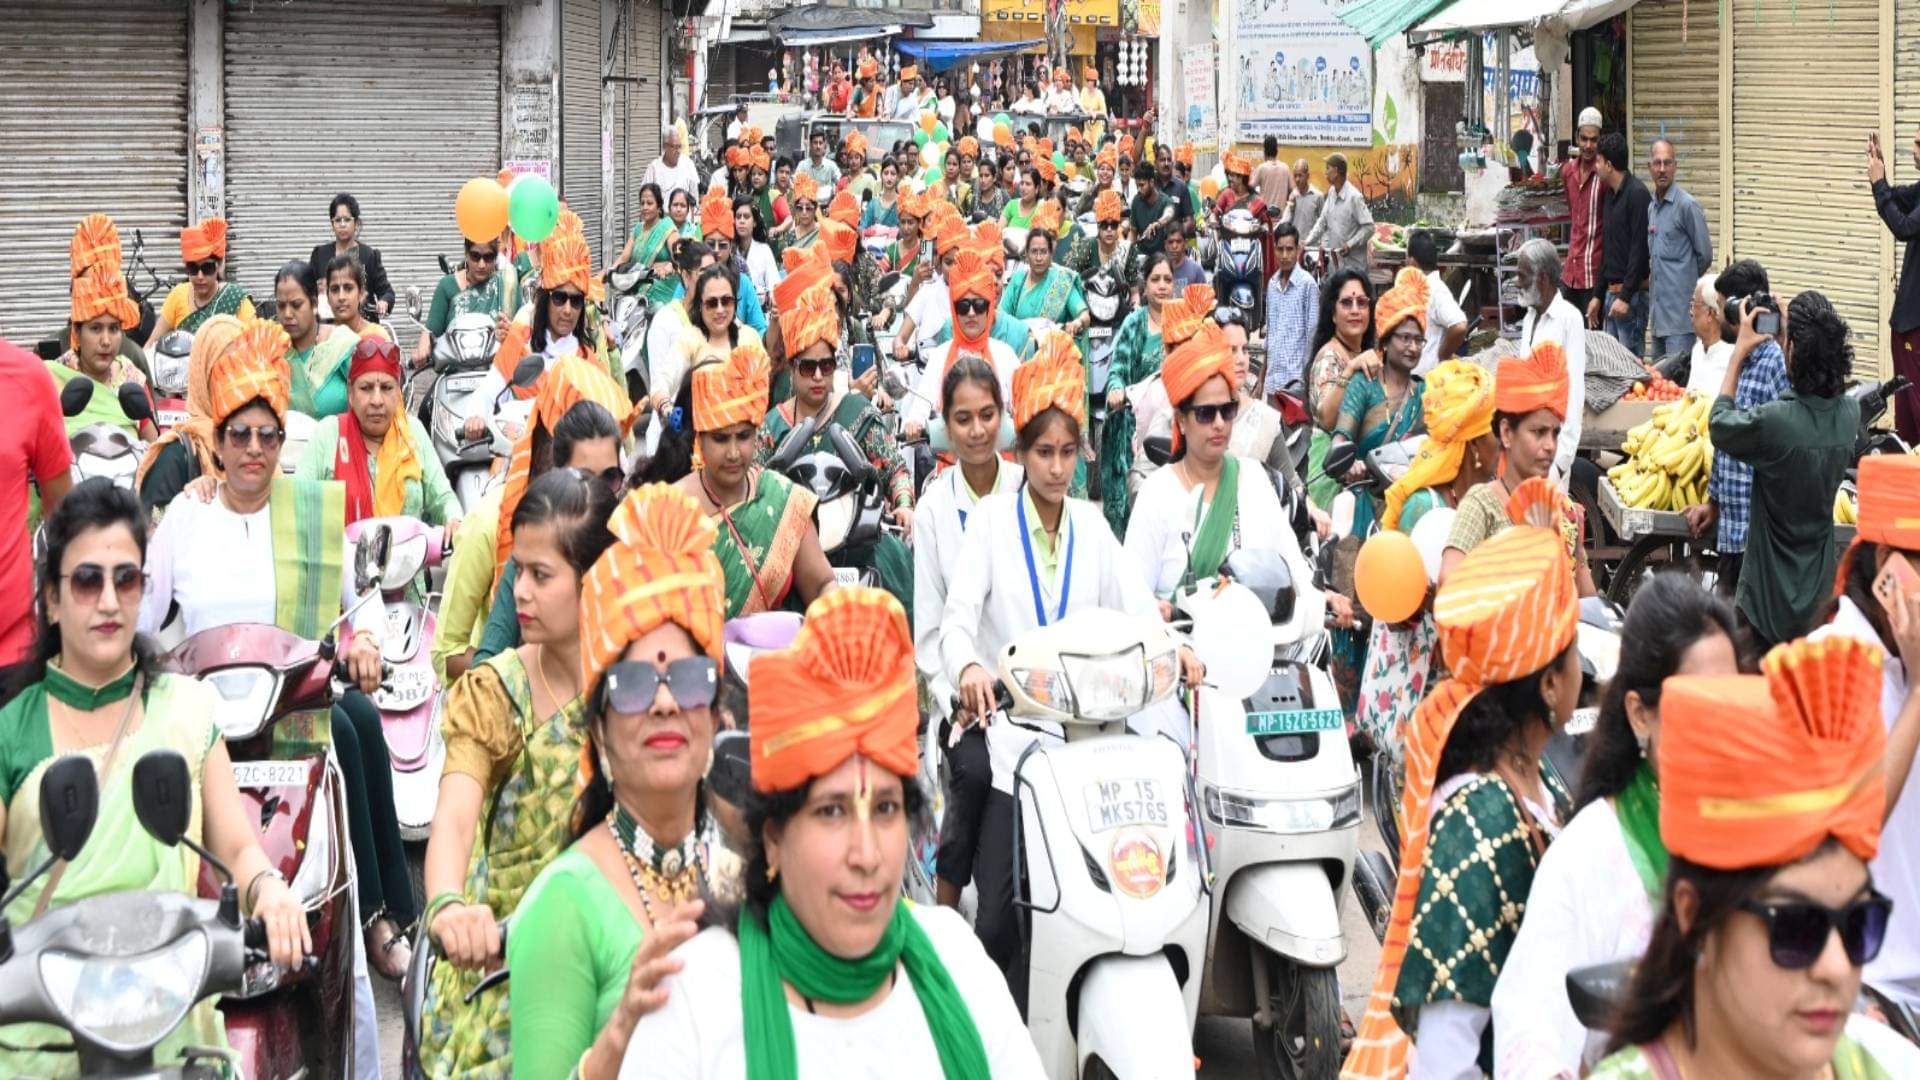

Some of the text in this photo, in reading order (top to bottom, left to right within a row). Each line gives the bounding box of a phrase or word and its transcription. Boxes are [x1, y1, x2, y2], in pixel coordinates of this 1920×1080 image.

[1098, 781, 1155, 804] MP 15
[1100, 802, 1168, 826] MK5765
